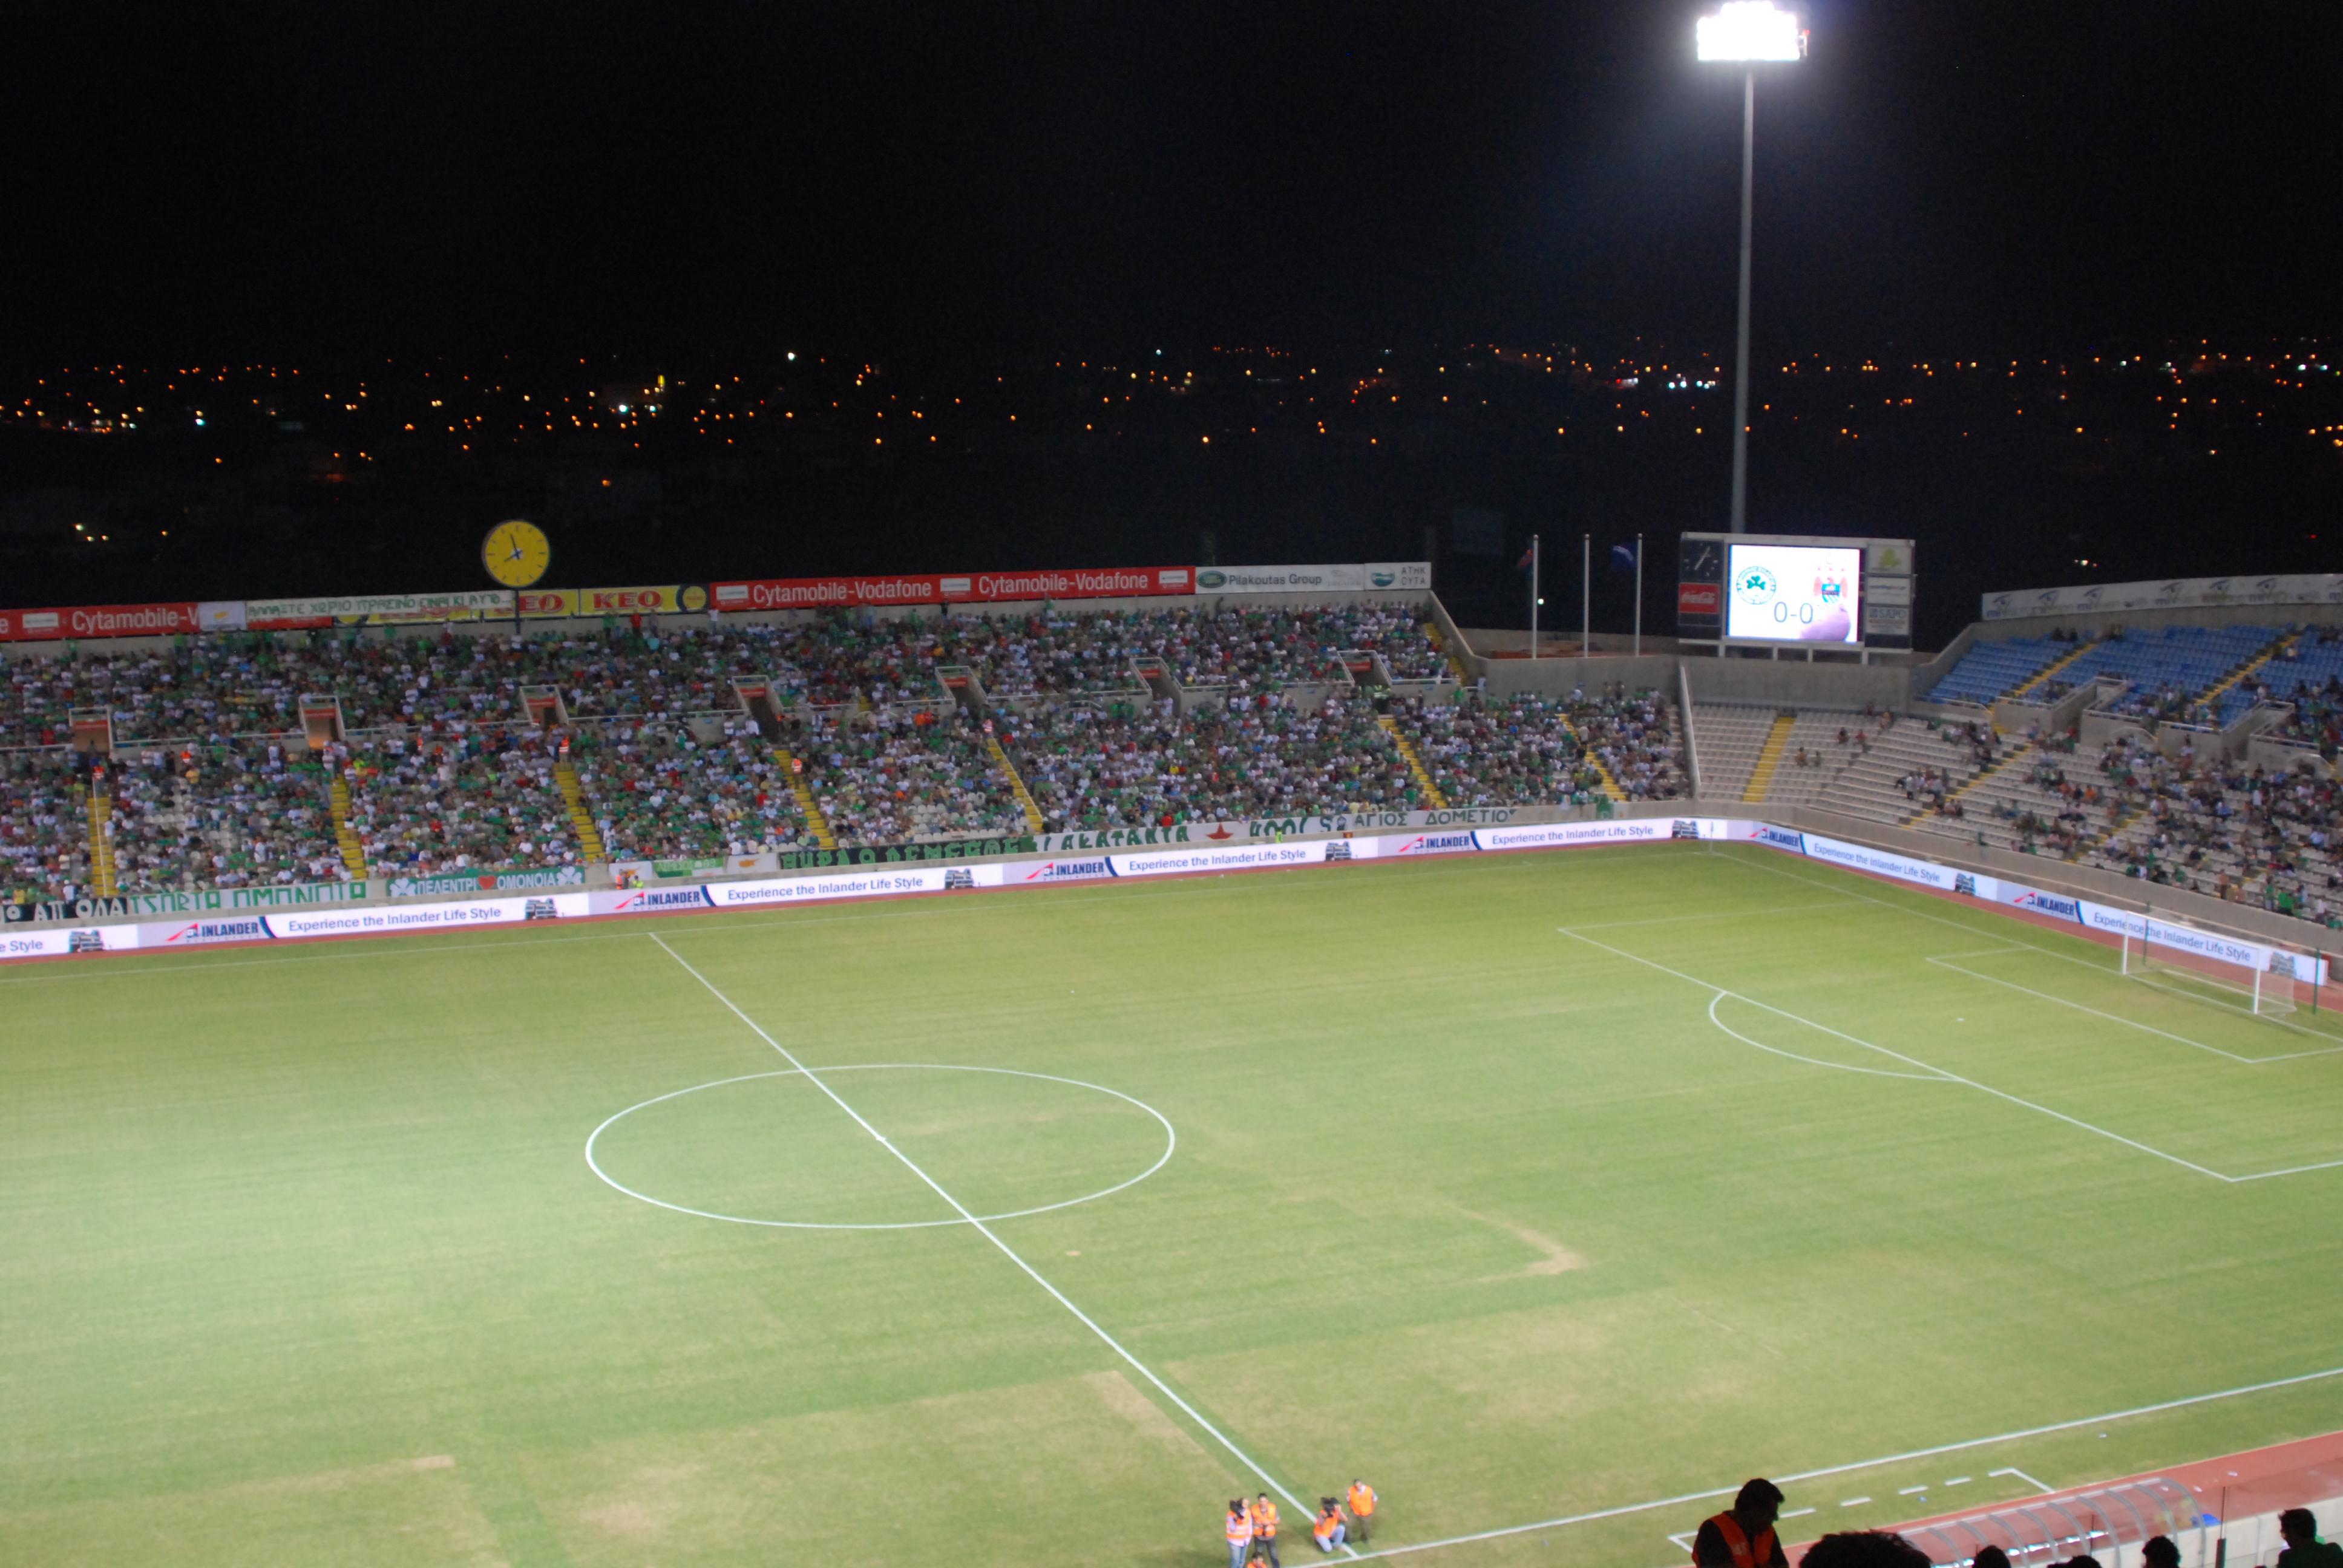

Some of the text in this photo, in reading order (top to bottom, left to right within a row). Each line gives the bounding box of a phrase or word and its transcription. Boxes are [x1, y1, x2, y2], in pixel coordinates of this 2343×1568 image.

[978, 572, 1149, 596] Cytamobile-Vodafone
[1229, 574, 1285, 585] Pilakoutas
[1289, 573, 1322, 586] Group
[593, 590, 663, 612] KEO
[753, 580, 932, 606] Cytamobile-Vodafone
[1426, 835, 1469, 848] INLANDER
[1493, 826, 1654, 845] Experience the Inlander Life Style
[1769, 830, 1800, 848] INLANDER
[1056, 862, 1104, 875] INLANDER
[1130, 849, 1306, 871] Experience the Inlander Life Style
[1814, 843, 1941, 883] Experience the Inlander Life Style
[647, 892, 700, 905] INLANDER
[728, 877, 923, 901] Experience the Inlander Life Style
[2037, 895, 2075, 915] INLANDER
[289, 907, 502, 932] Experience the Inlander Life Style
[202, 923, 258, 937] INLANDER
[2094, 912, 2251, 962] Experience the Inlander Life Style
[10, 939, 43, 953] Style
